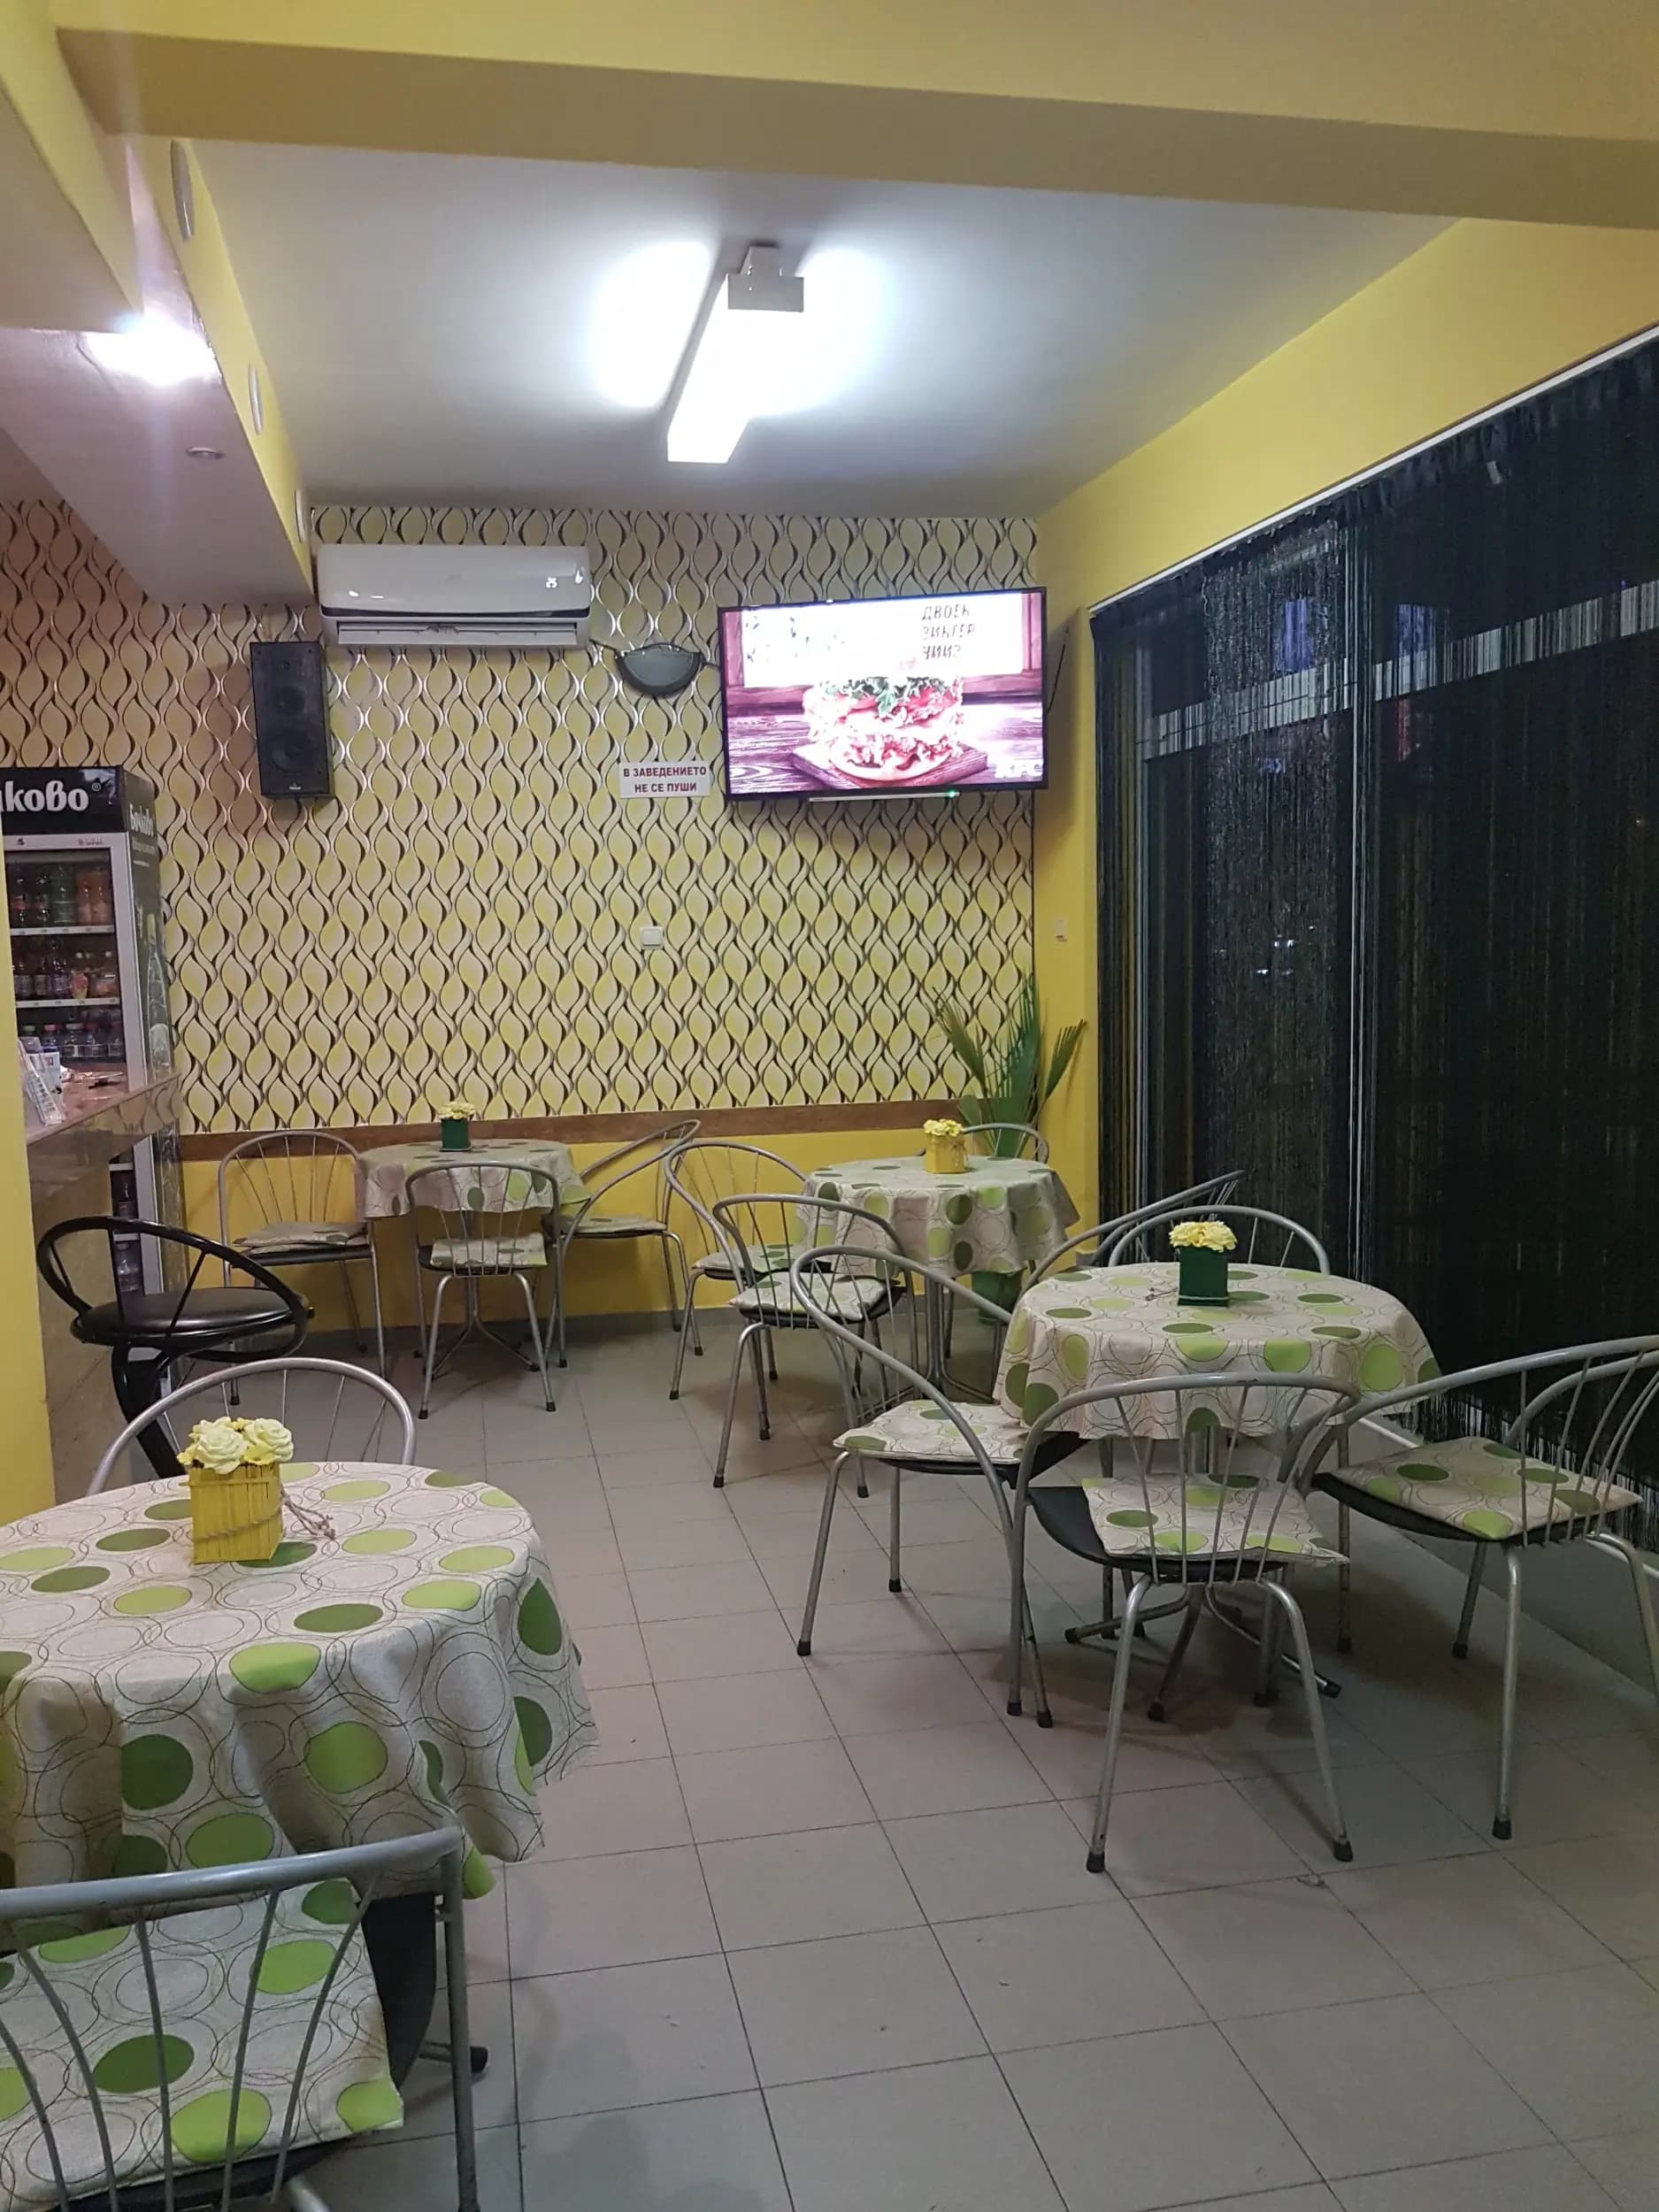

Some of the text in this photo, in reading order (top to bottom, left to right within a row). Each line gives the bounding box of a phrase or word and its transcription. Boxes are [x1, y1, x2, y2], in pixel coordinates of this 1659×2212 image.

[623, 766, 707, 779] В ЗАВЕДЕНИЕТО
[634, 782, 697, 793] НЕ СЕ ПУШИ
[0, 780, 89, 812] ково
